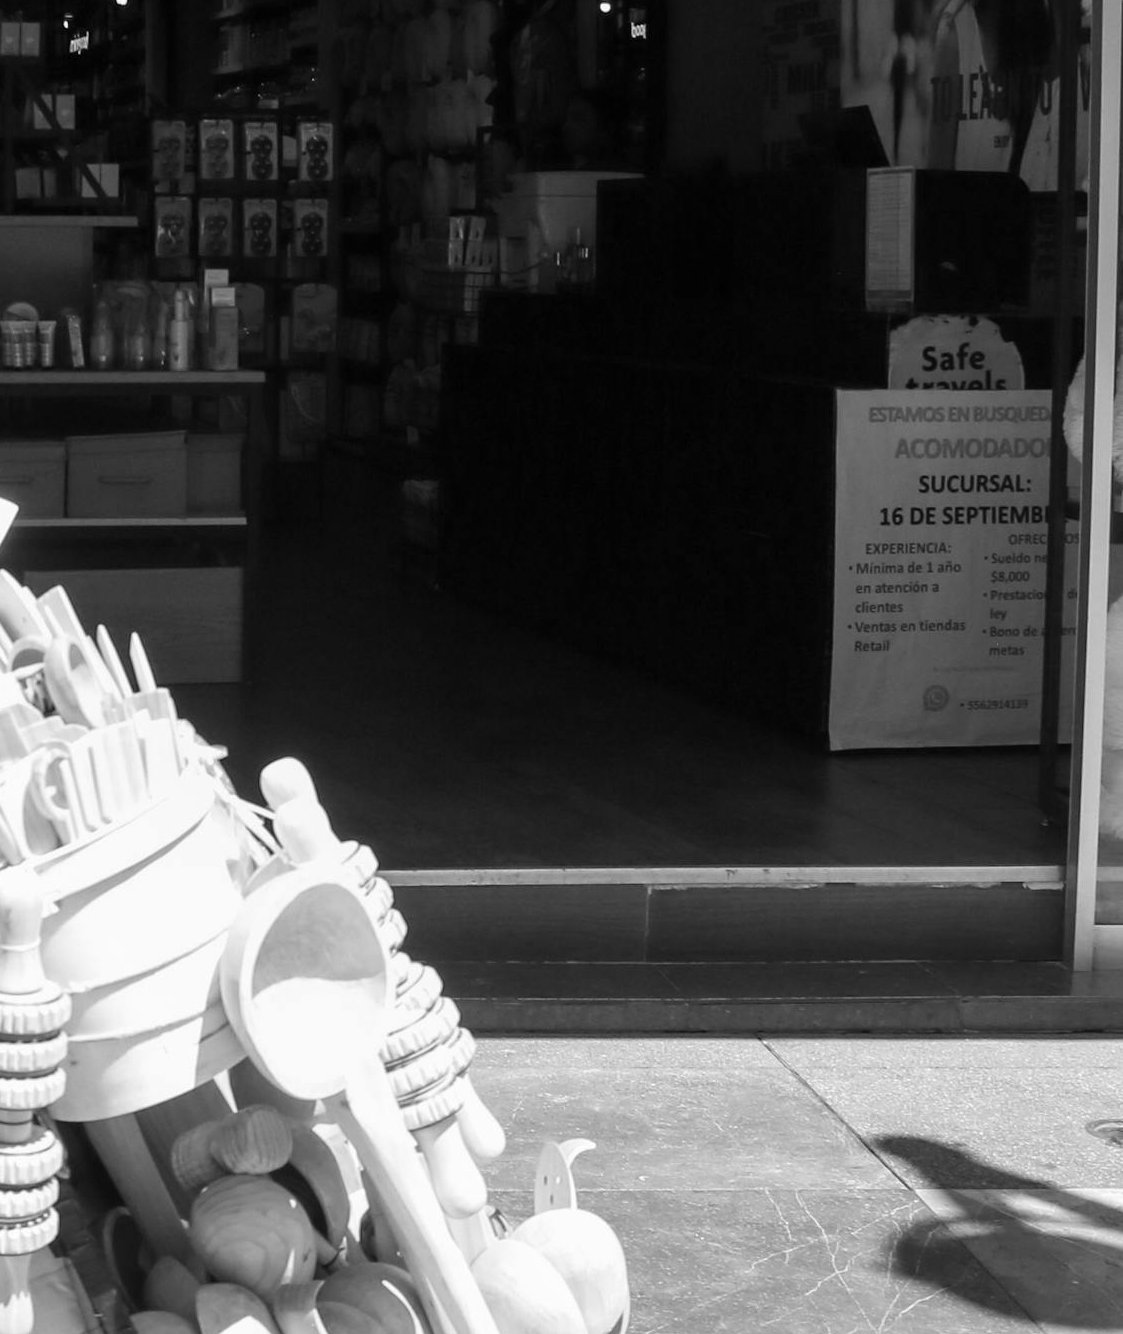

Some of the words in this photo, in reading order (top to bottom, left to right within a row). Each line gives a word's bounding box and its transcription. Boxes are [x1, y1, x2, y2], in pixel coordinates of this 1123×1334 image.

[921, 342, 986, 372] Safe
[869, 406, 945, 423] ESTAMOS
[948, 406, 970, 423] EN
[973, 405, 1052, 424] BUSQUED
[894, 437, 1051, 459] ACOMODADO
[918, 474, 1032, 493] SUCURSAL:
[880, 507, 904, 526] 16
[910, 507, 937, 525] DE
[865, 543, 953, 555] EXPERIENCIA:
[991, 553, 1031, 565] Sueldo
[856, 561, 905, 574] Mínima
[907, 561, 924, 574] de
[926, 562, 934, 573] 1
[937, 562, 962, 573] año
[990, 570, 1030, 584] $8,000
[855, 584, 871, 595] en
[875, 581, 928, 594] atención
[932, 583, 940, 593] a
[855, 601, 904, 613] clientes
[989, 609, 1007, 621] ley
[855, 621, 897, 633] Ventas
[900, 622, 916, 633] en
[919, 620, 966, 632] tiendas
[989, 626, 1020, 637] Bono
[1023, 626, 1038, 637] de
[854, 640, 890, 652] Retail
[988, 645, 1025, 657] metas
